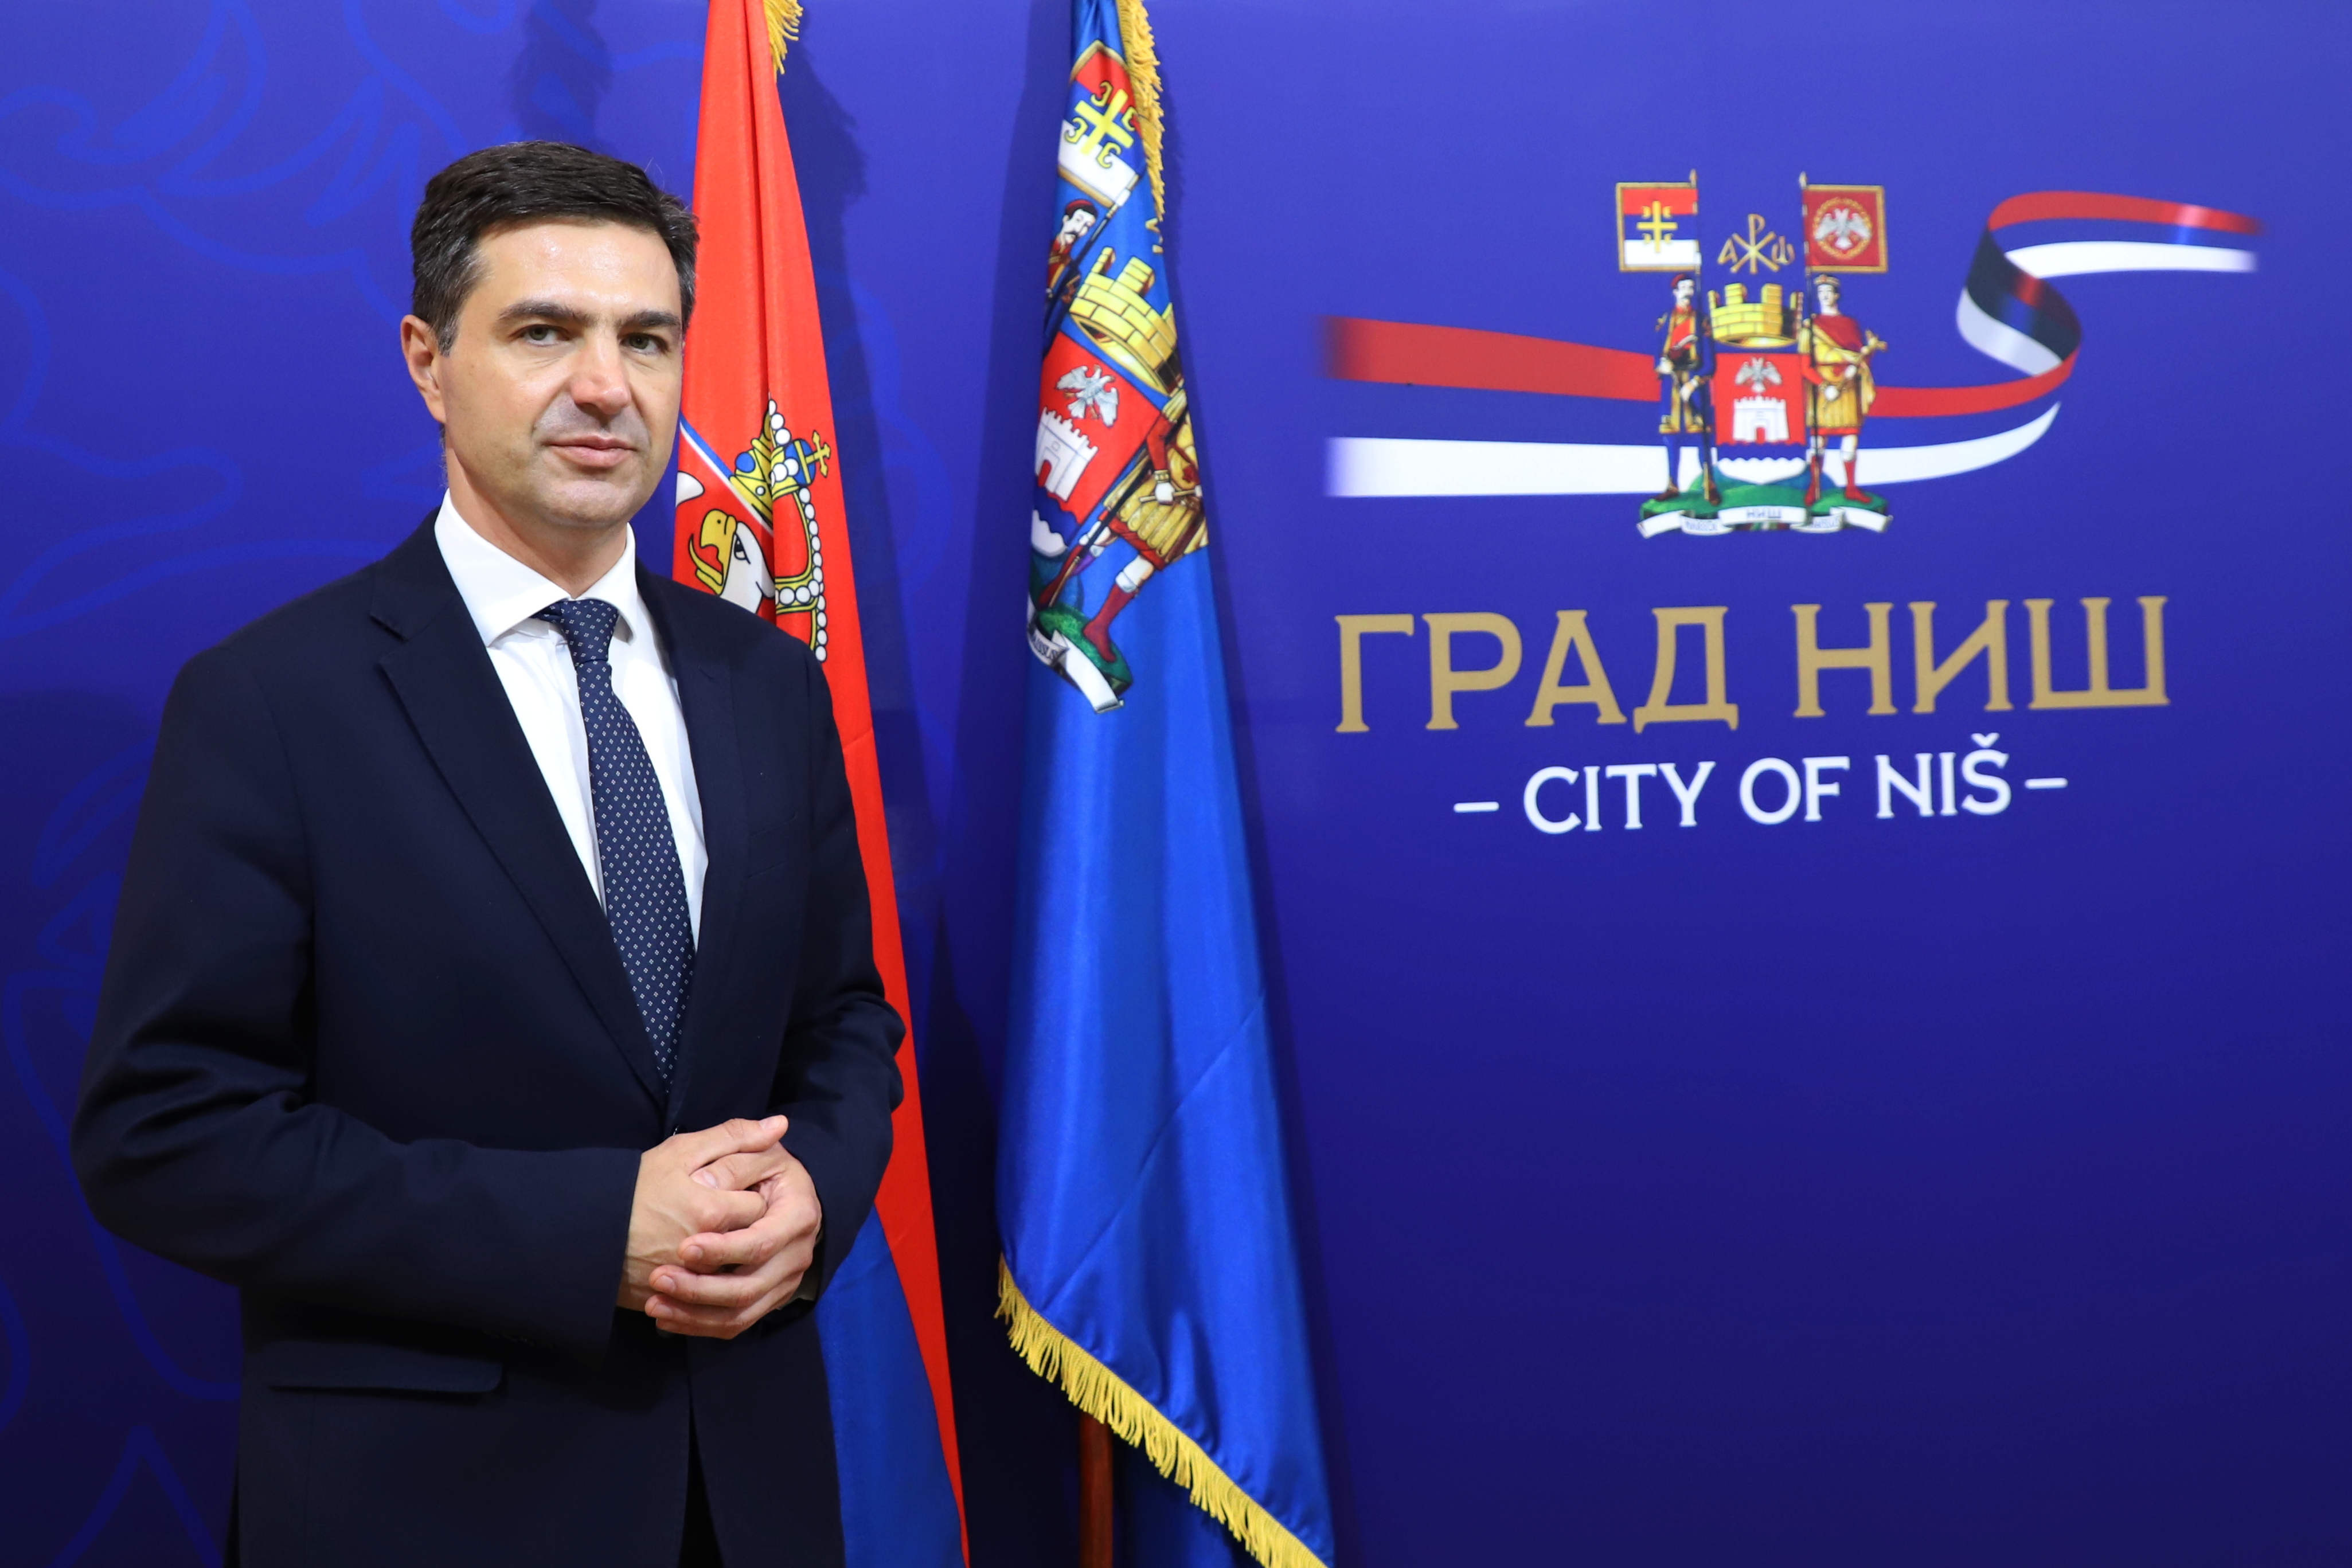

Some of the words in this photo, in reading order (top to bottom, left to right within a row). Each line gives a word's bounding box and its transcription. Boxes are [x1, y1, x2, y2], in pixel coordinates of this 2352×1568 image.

[1335, 605, 1738, 733] ГРАД
[1791, 596, 2169, 717] НИШ
[1522, 760, 1716, 835] CITY
[1738, 755, 1851, 826] OF
[1874, 732, 2012, 820] NIŠ
